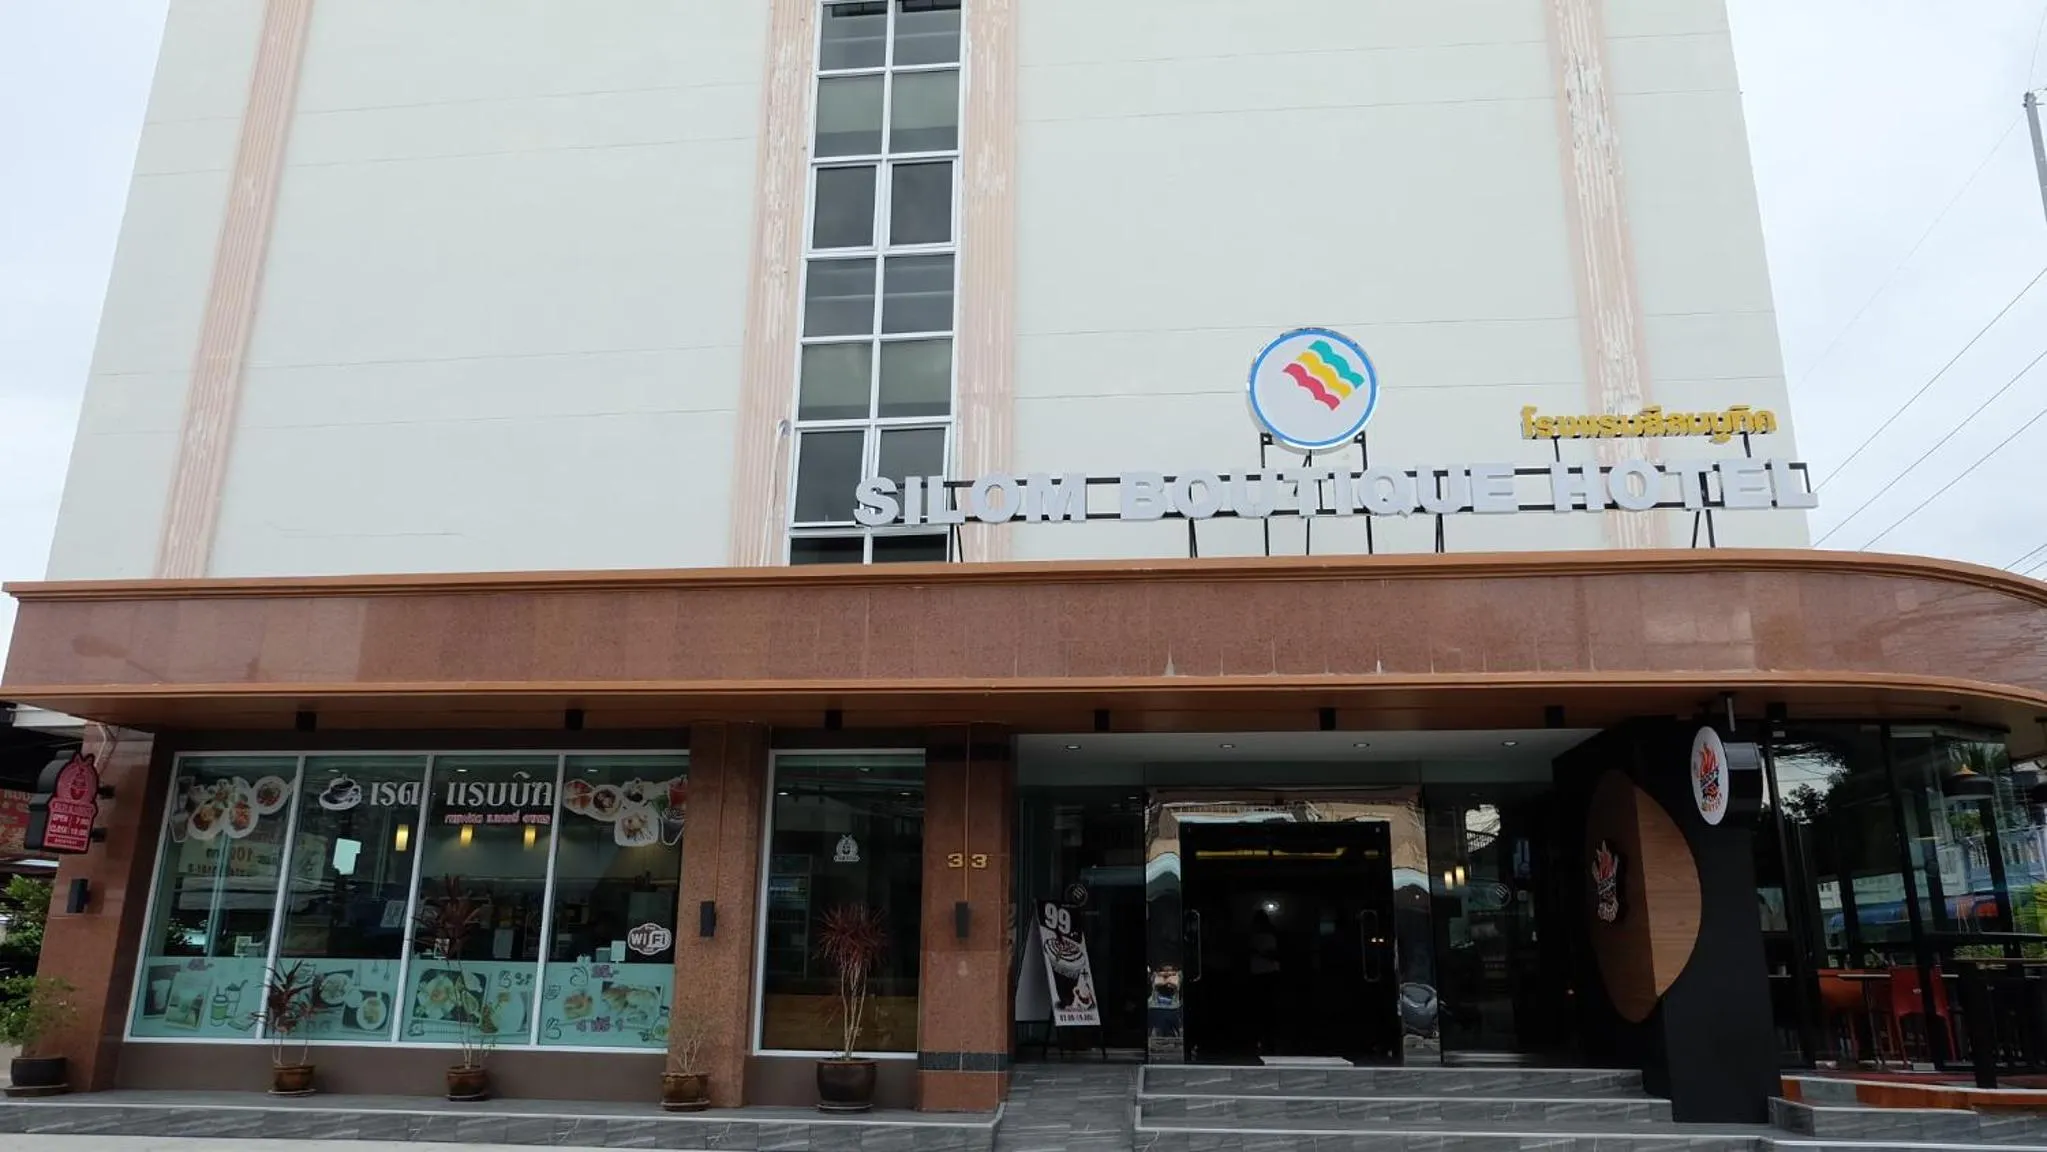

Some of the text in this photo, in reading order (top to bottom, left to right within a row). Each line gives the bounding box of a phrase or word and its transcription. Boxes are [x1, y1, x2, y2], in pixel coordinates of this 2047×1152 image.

[853, 457, 1819, 527] SILOM BOUTIQUE HOTEL
[947, 852, 988, 869] 33
[1044, 902, 1071, 935] 99
